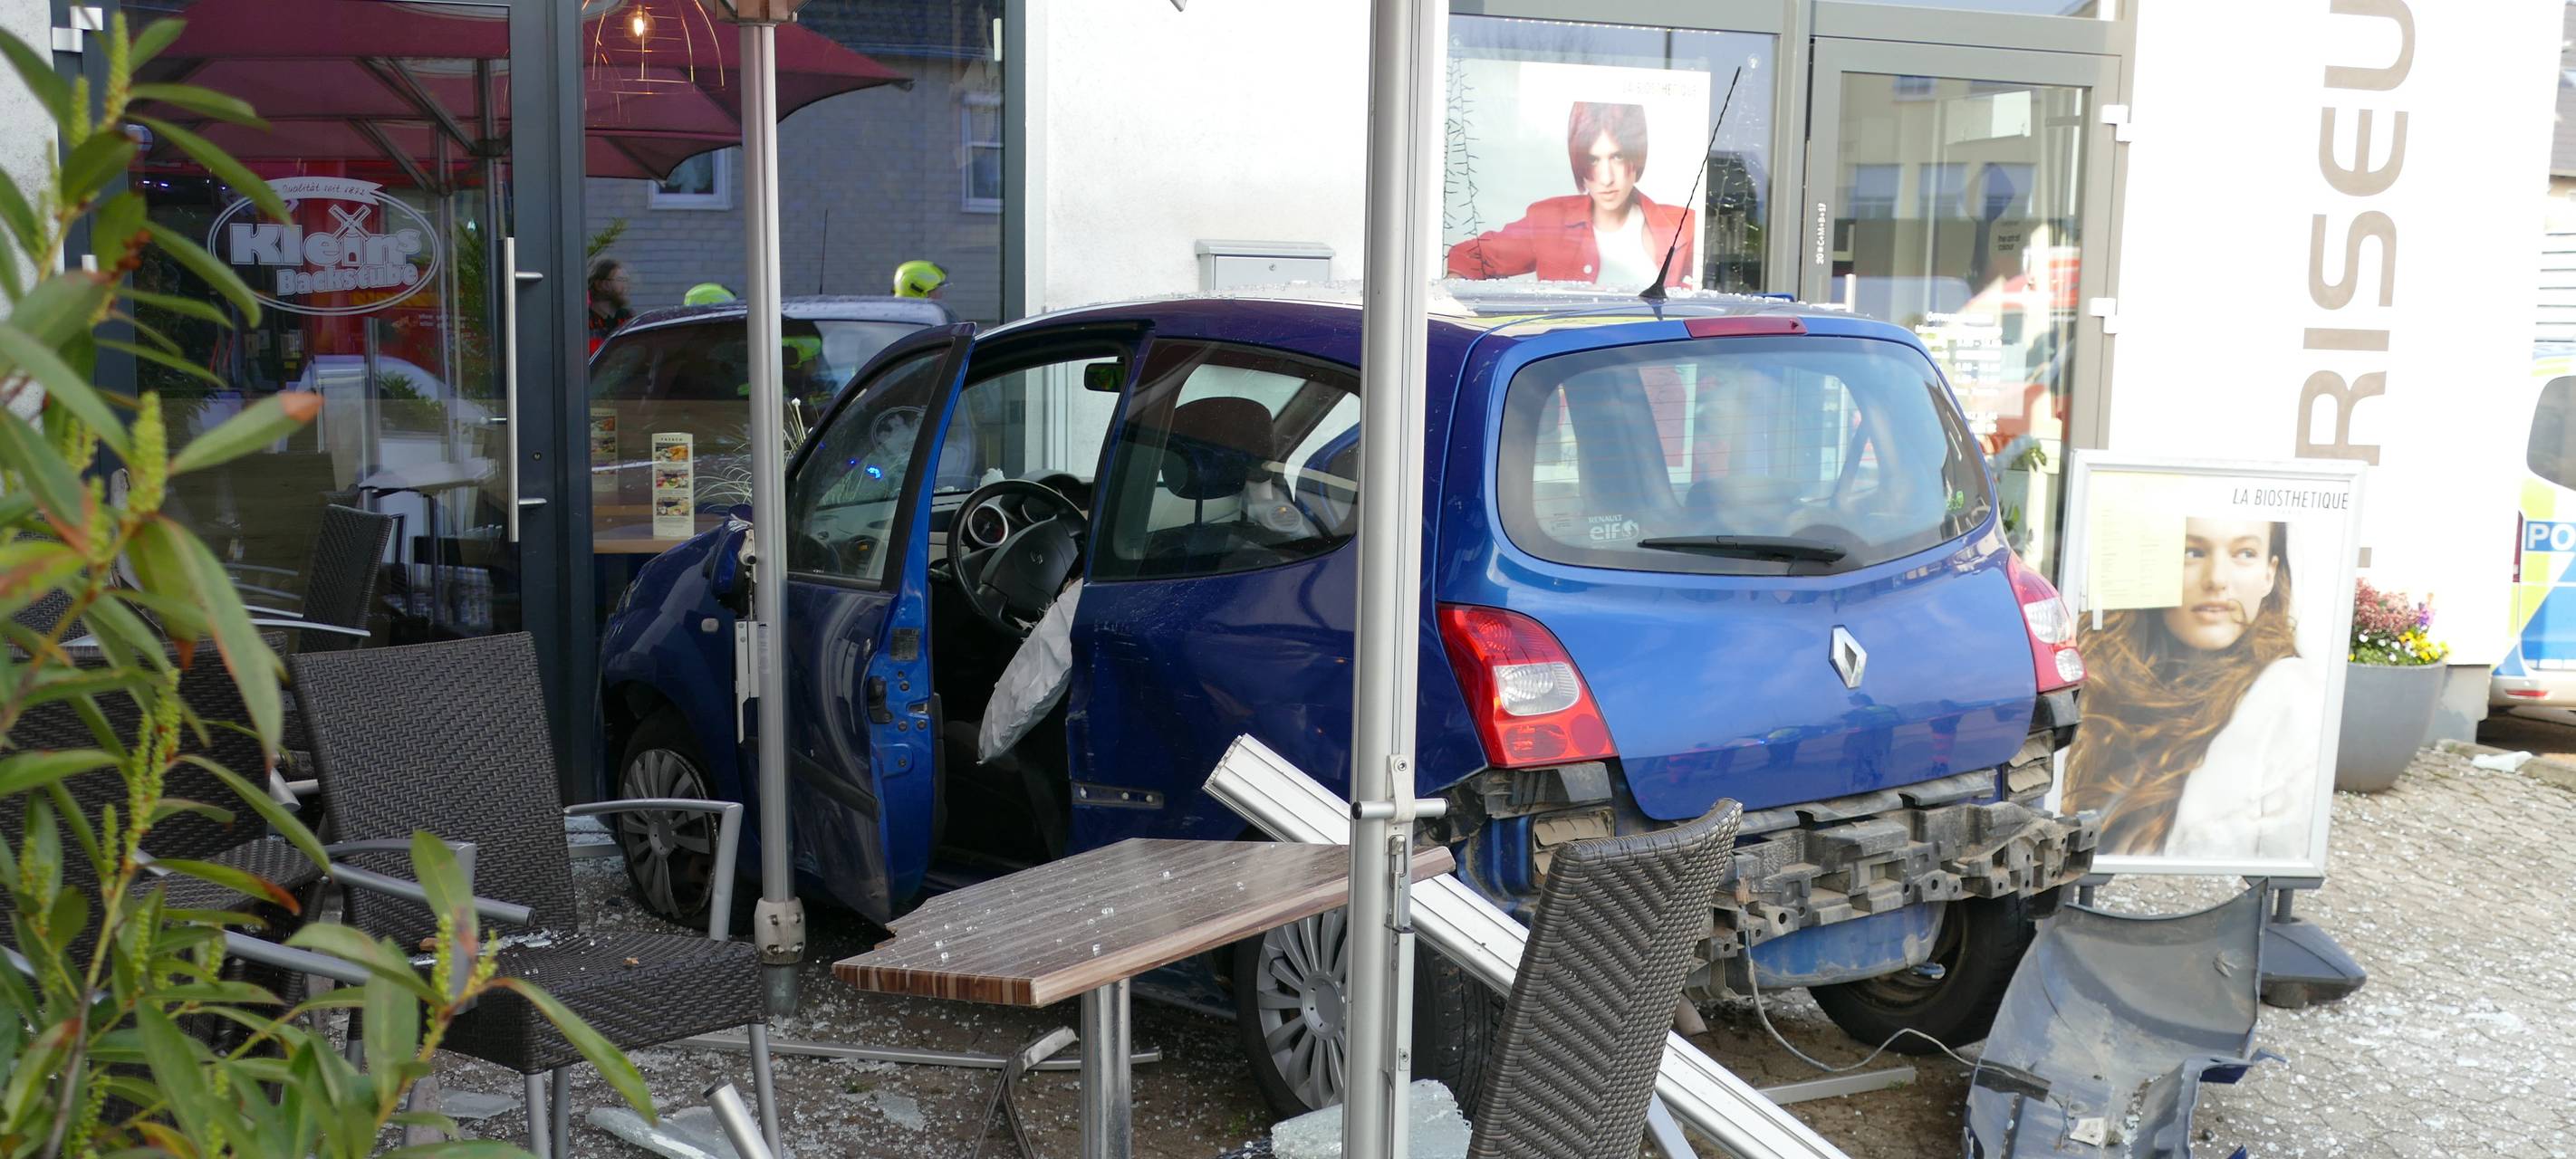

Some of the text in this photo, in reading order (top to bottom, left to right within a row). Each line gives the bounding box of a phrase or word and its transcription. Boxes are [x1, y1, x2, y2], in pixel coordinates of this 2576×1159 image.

[276, 262, 419, 296] Backstube
[2295, 0, 2416, 568] RISEU
[2232, 487, 2350, 510] LA BIOSTHETIQUE
[1588, 513, 1623, 523] RENAULT
[1589, 522, 1621, 541] elf
[2527, 522, 2576, 551] PO
